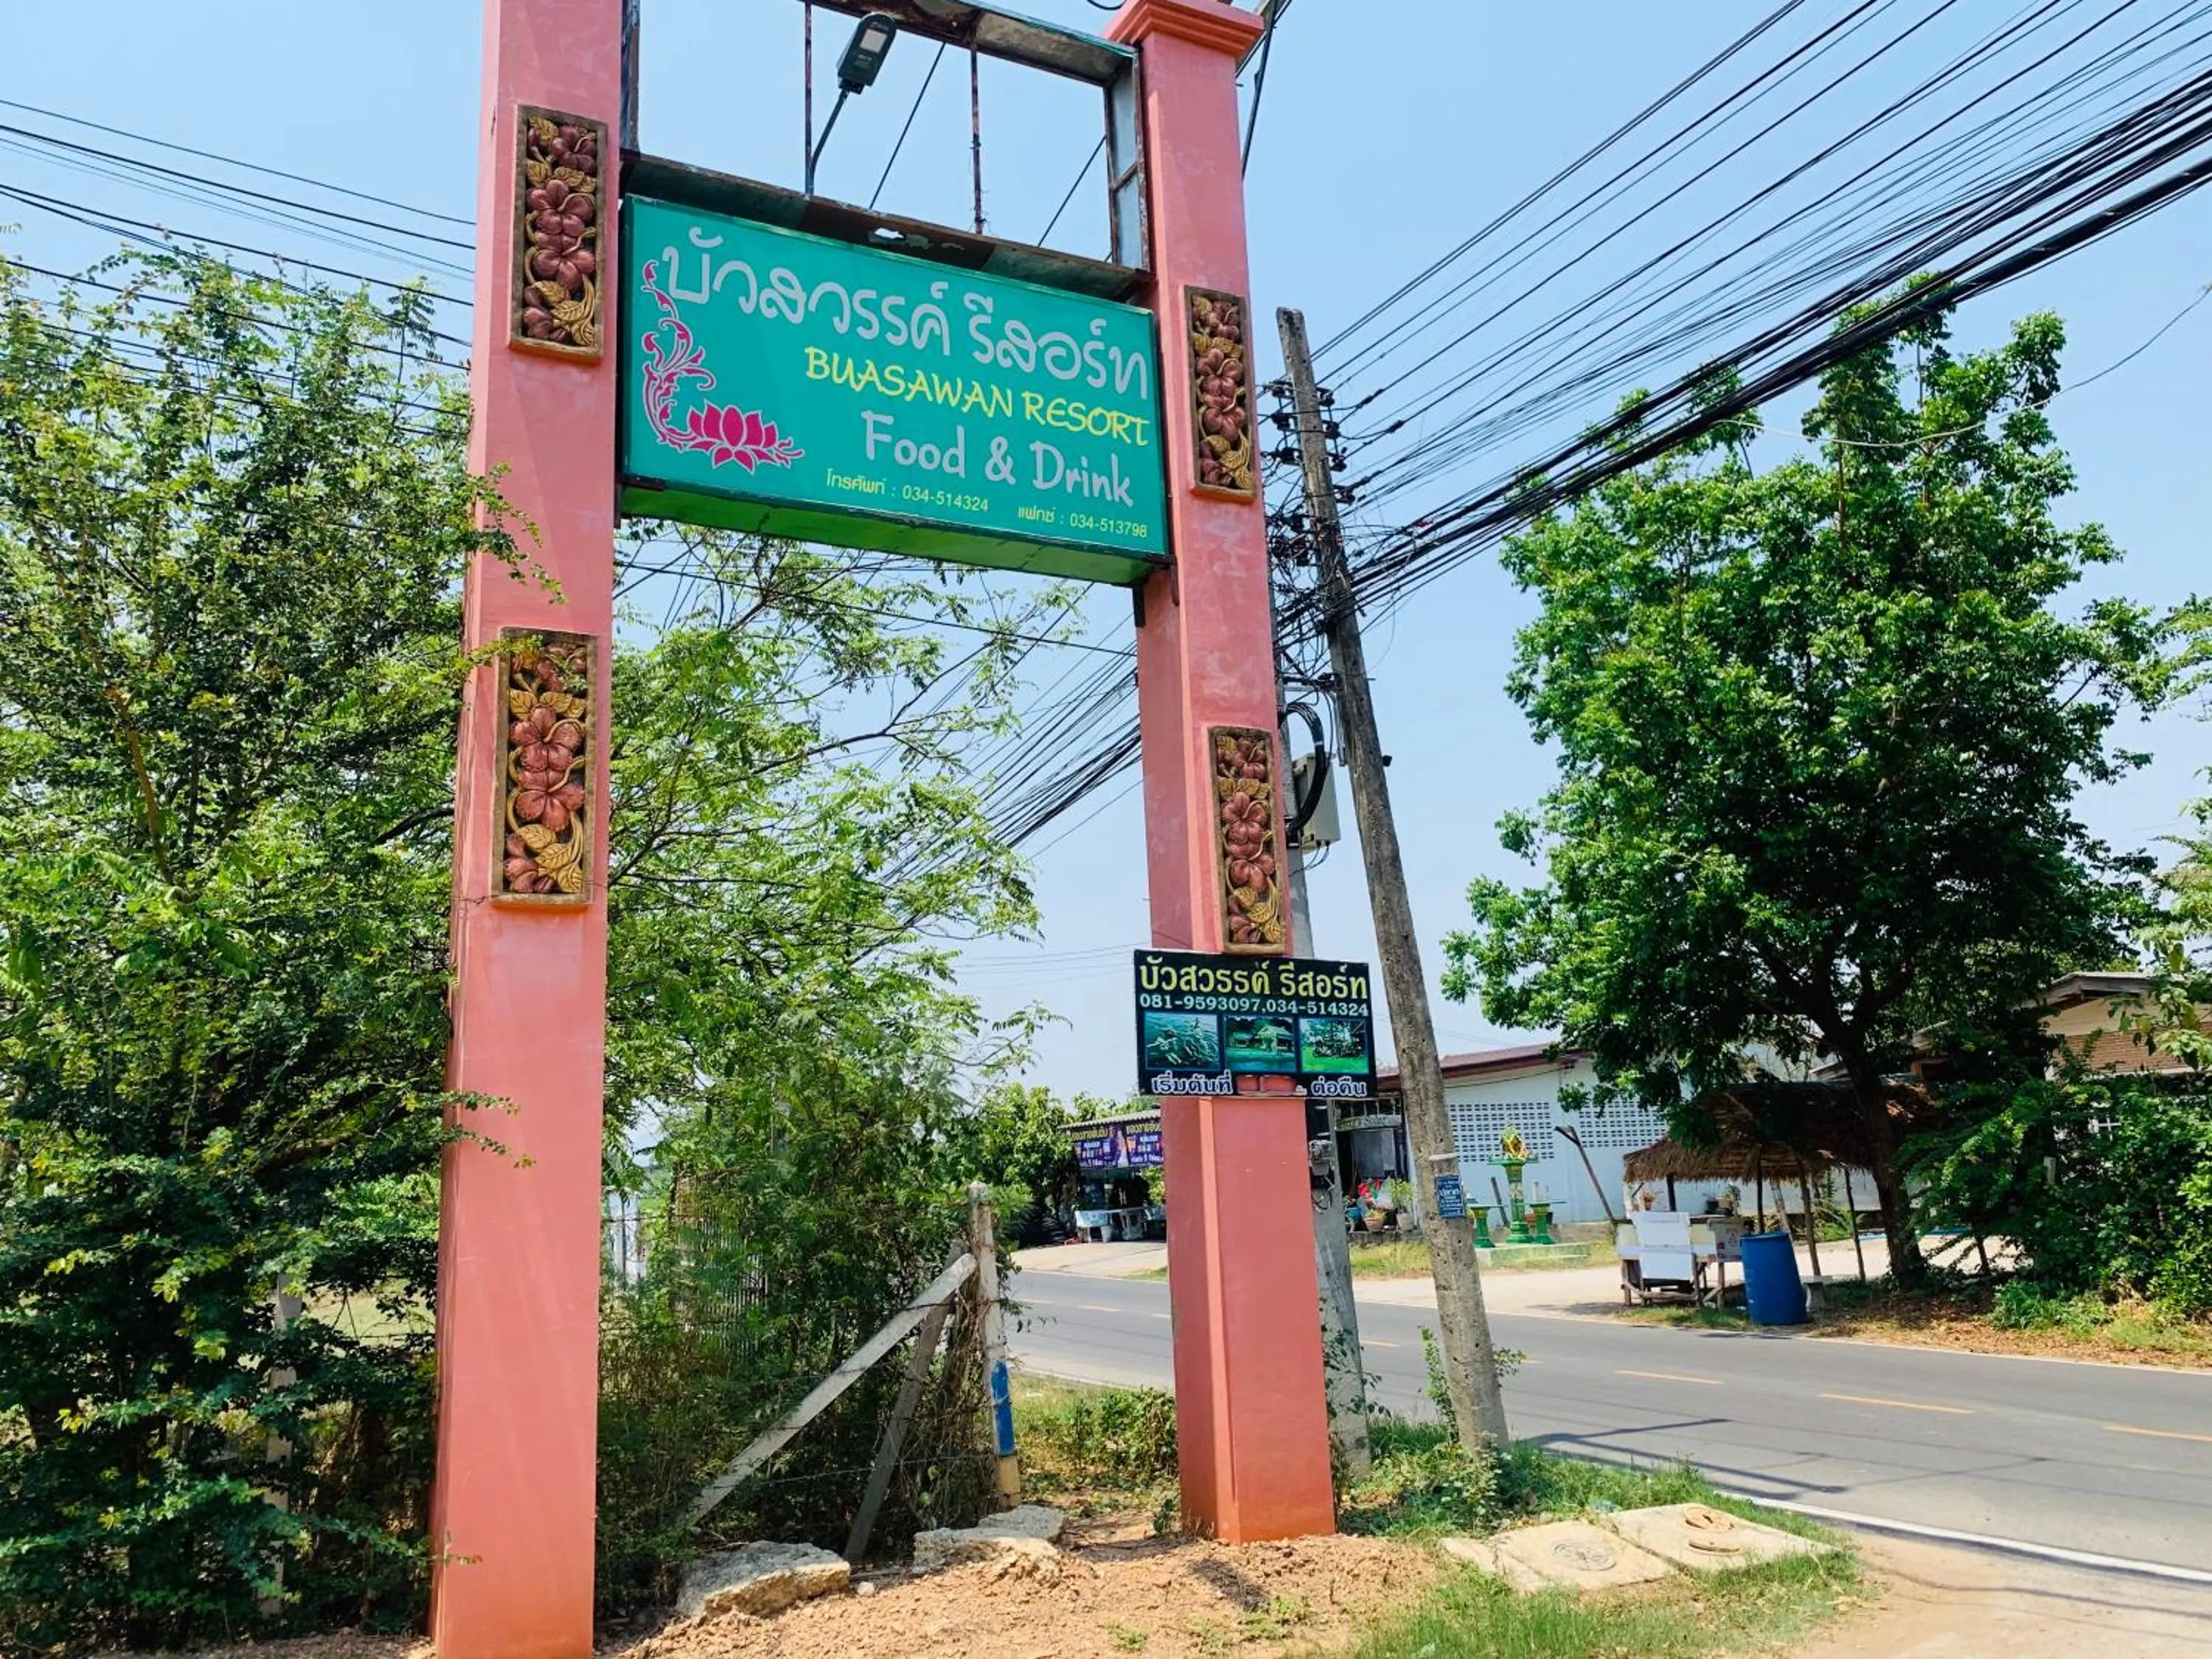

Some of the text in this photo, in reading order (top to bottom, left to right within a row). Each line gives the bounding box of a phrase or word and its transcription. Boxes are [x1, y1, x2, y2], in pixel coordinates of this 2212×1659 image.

[663, 226, 1149, 400] บัวสวรรค์ รีสอร์ท
[804, 347, 1152, 446] BUASAWAN RESORT
[860, 410, 1133, 507] Food & Drink
[826, 467, 887, 495] โทรศัพท์
[902, 484, 990, 512] 034-514324
[1018, 505, 1057, 524] แฟกซ์
[1069, 512, 1148, 539] 034-513798
[1139, 955, 1368, 1000] บัวสวรรค์ รีสอร์ท
[1310, 1074, 1368, 1097] ต่อคืน
